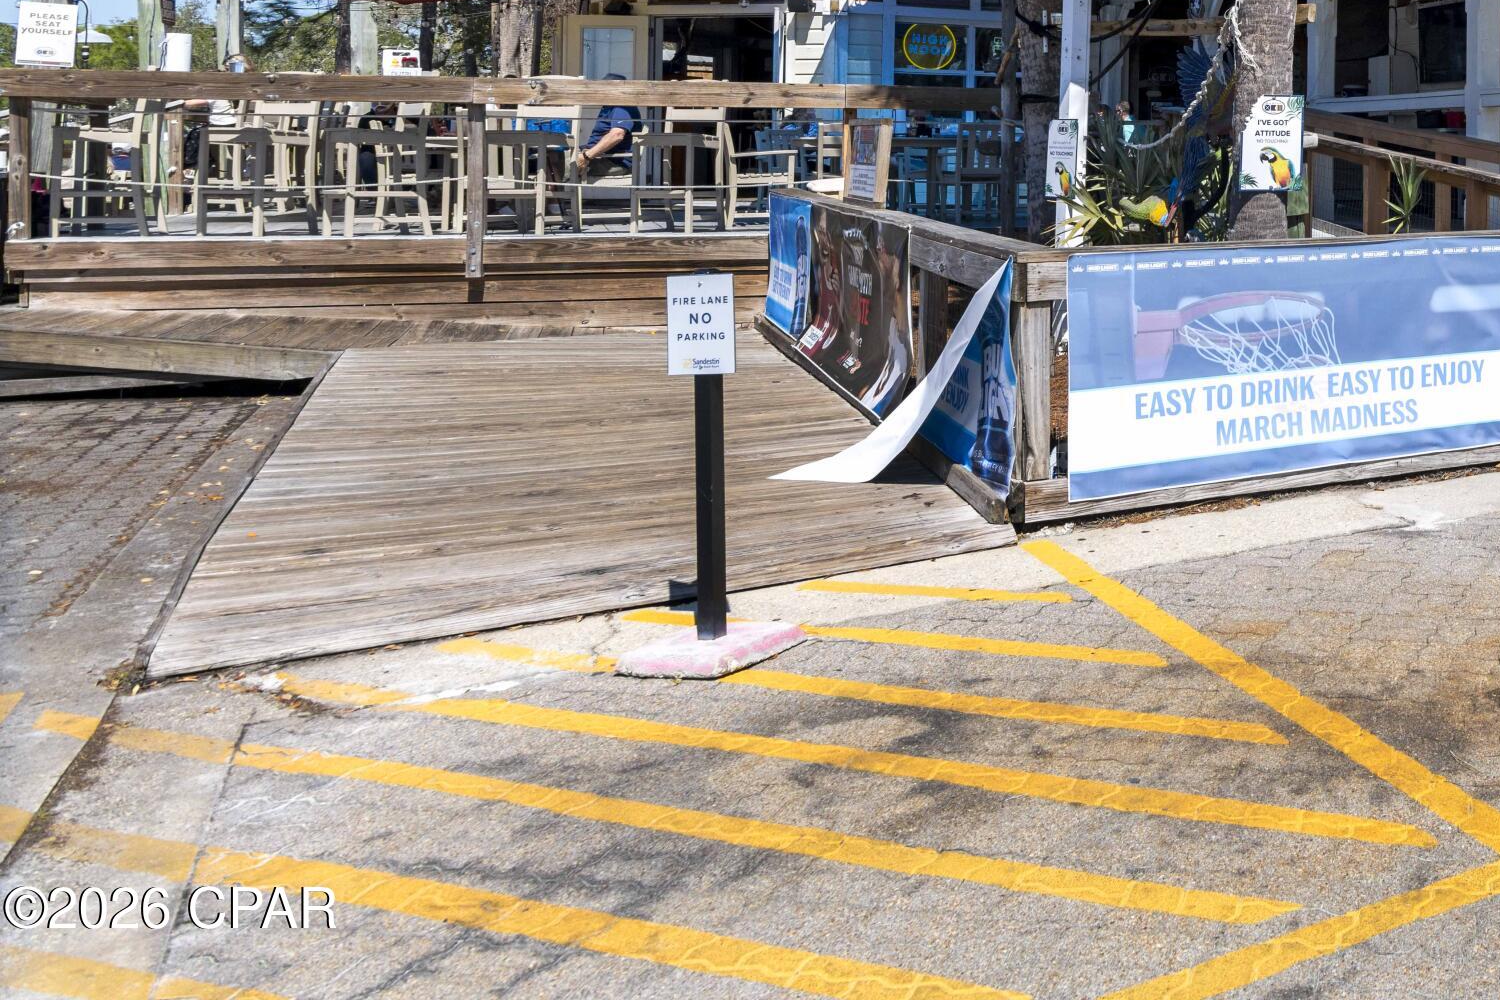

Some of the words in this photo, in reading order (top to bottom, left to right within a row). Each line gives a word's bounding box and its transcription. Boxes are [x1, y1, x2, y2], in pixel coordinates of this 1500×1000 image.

[30, 12, 69, 20] PLEASE
[21, 27, 73, 36] YOURSELF
[672, 297, 696, 306] FIRE
[701, 296, 728, 305] LANE
[689, 312, 712, 324] NO
[677, 332, 726, 341] PARKING
[1135, 386, 1197, 420] EASY
[1203, 383, 1233, 411] TO
[1241, 375, 1315, 408] DRINK
[1327, 367, 1384, 398] EASY
[1387, 365, 1415, 390] TO
[1421, 359, 1485, 388] ENJOY
[1216, 410, 1302, 447] MARCH
[1311, 399, 1419, 434] MADNESS
